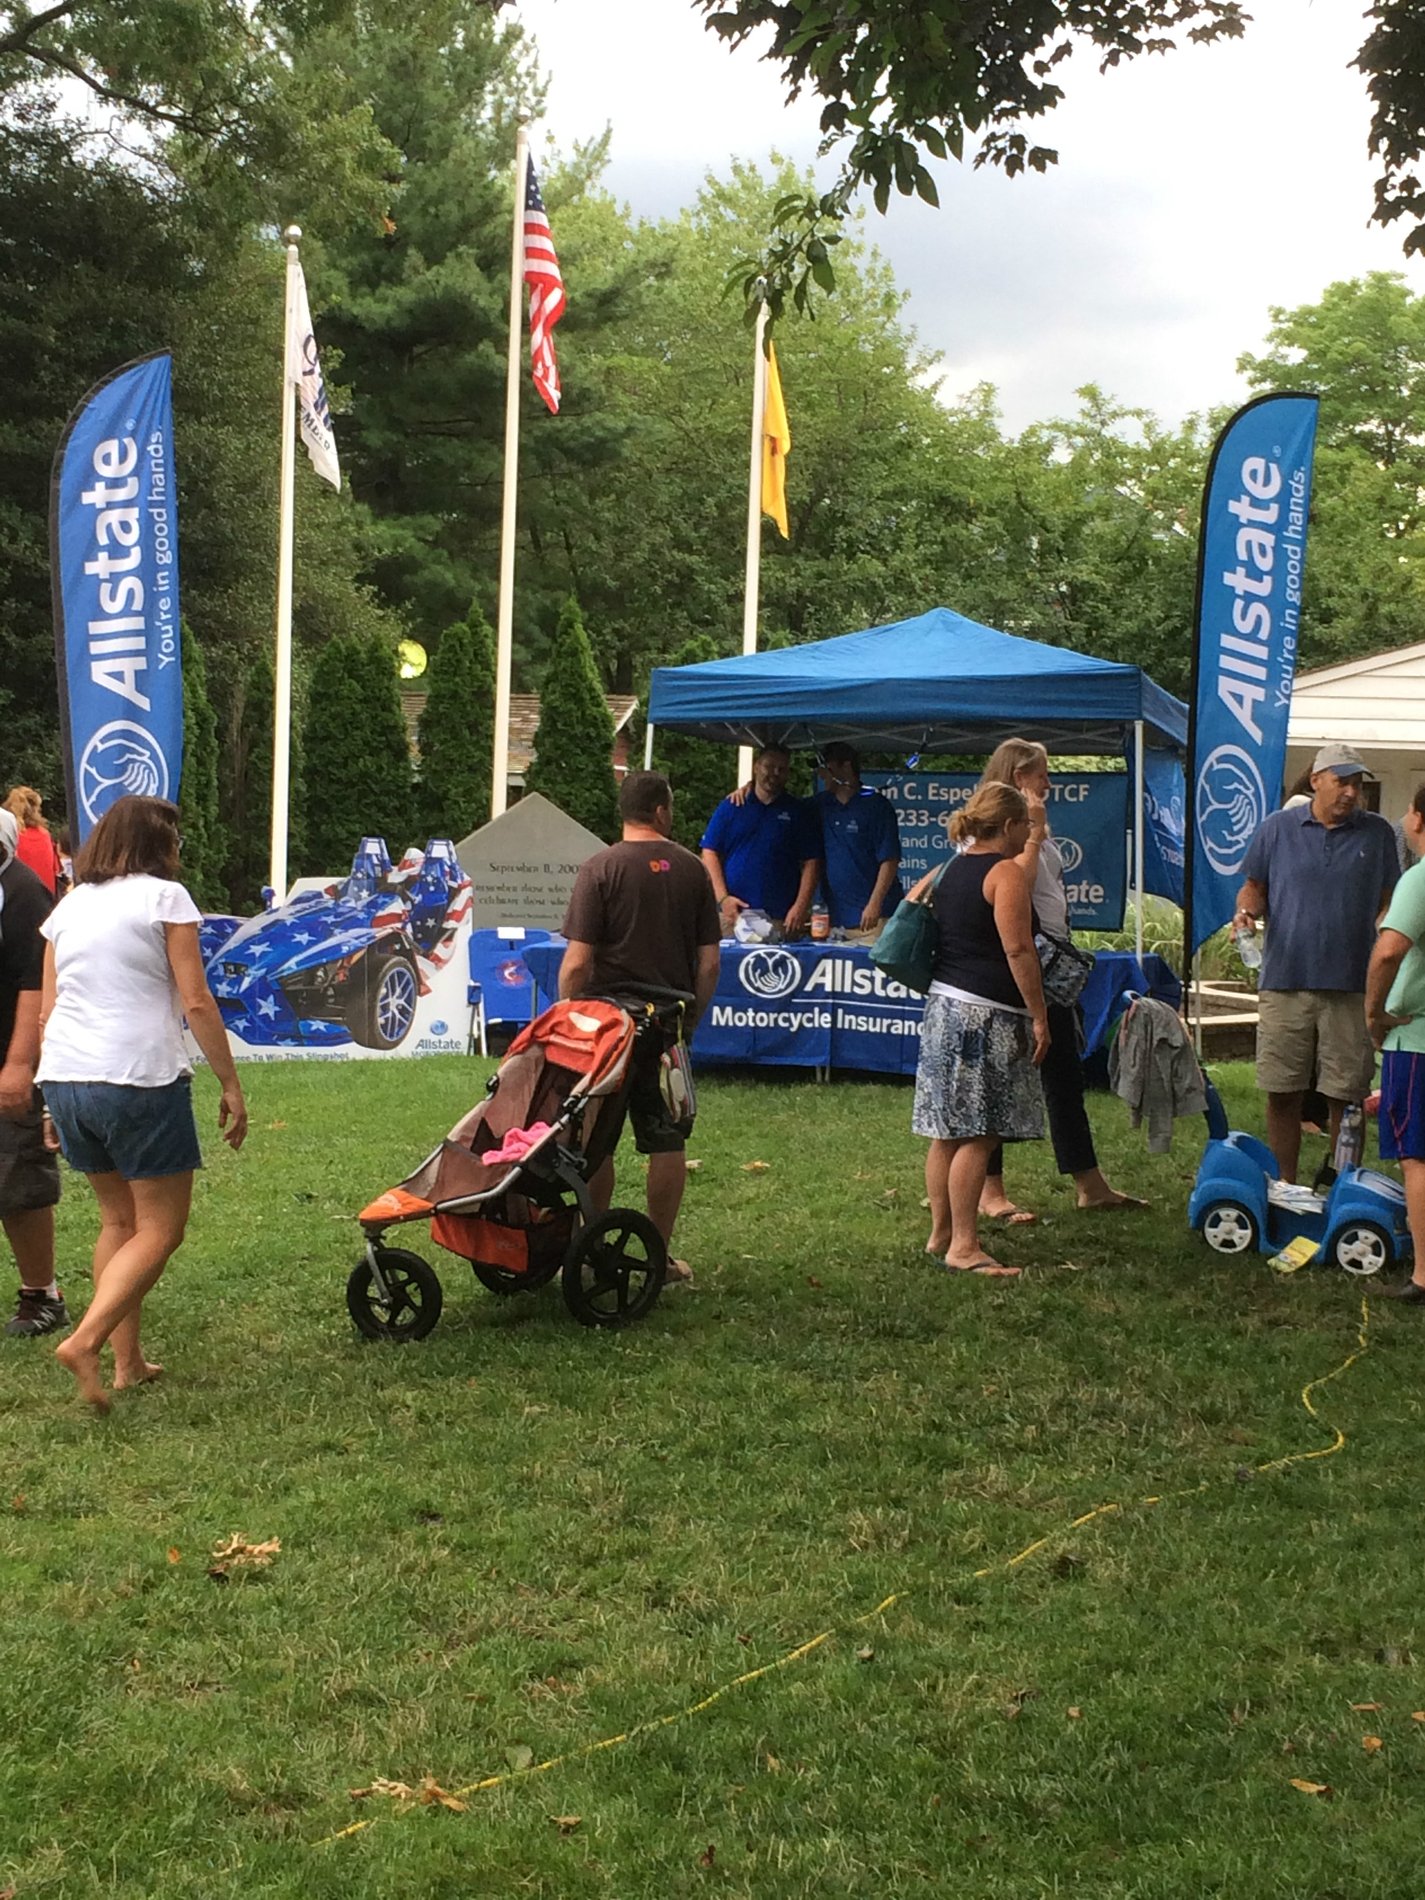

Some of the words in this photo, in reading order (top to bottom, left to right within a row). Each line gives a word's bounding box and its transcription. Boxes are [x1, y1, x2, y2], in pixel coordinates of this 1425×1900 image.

[147, 426, 166, 501] hands.
[1284, 466, 1305, 541] hands.
[148, 507, 172, 565] good
[81, 436, 151, 712] Allstate
[153, 570, 169, 592] in
[1284, 544, 1301, 603] good
[1218, 456, 1281, 747] Allstate
[1280, 608, 1298, 635] in
[153, 597, 176, 670] You're
[1274, 634, 1296, 708] You're
[903, 782, 922, 800] C.
[901, 834, 928, 848] and
[558, 863, 580, 874] 200
[1062, 880, 1105, 903] ate
[711, 1005, 832, 1032] Motorcycle
[415, 1038, 461, 1050] Allstate
